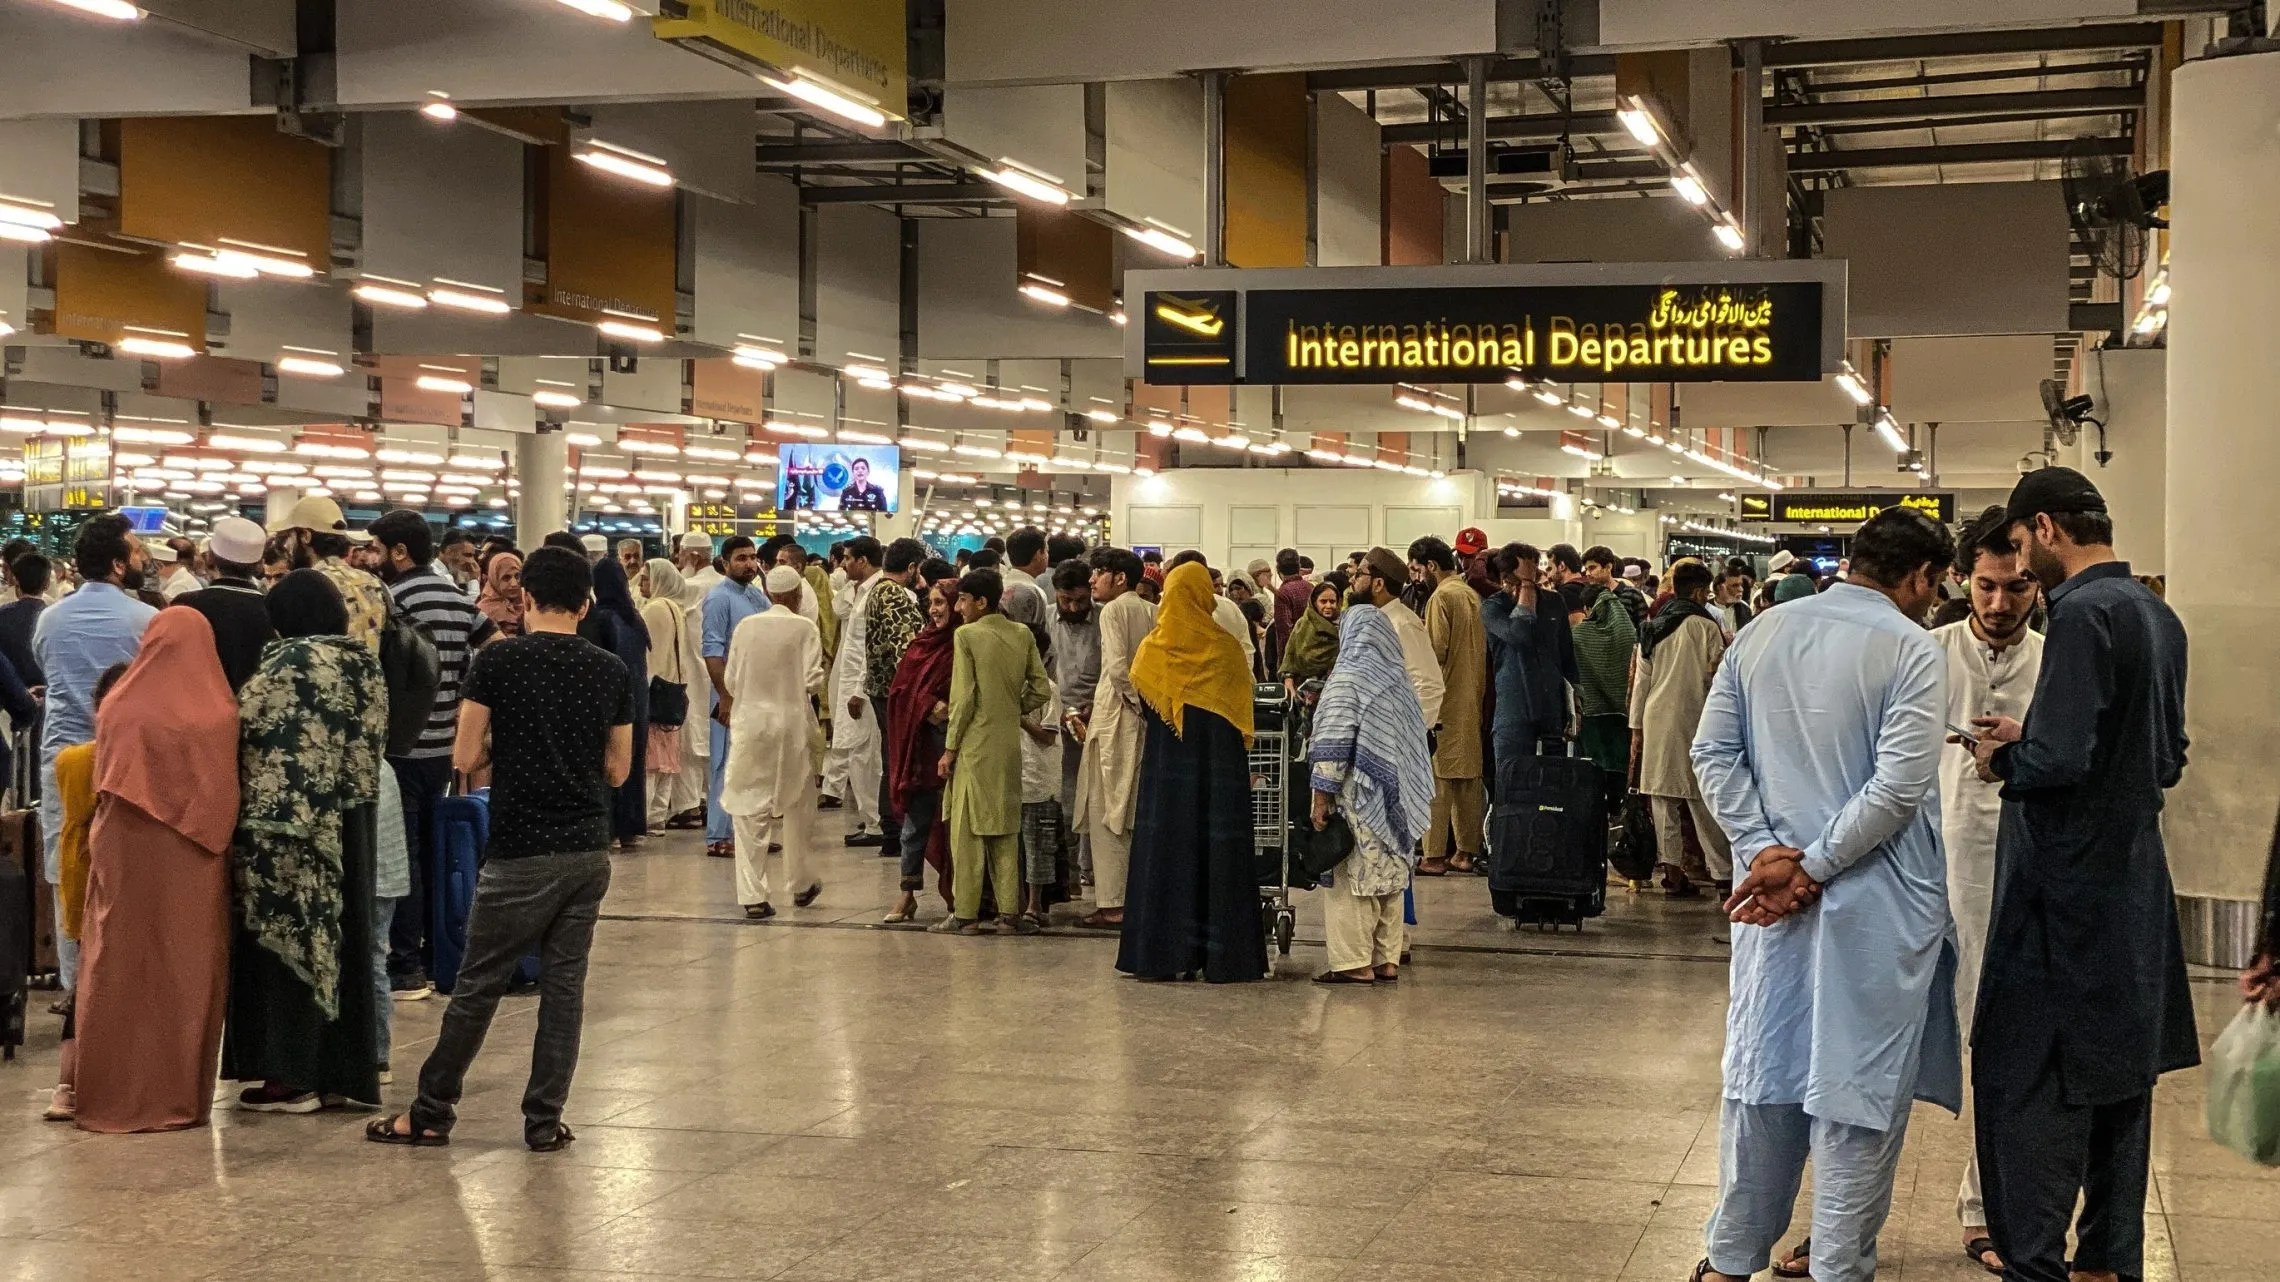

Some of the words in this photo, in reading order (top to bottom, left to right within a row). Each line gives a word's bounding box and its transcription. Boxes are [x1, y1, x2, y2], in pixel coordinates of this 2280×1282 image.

[1289, 329, 1534, 367] International
[1551, 331, 1772, 373] Departures
[1785, 506, 1866, 519] International
